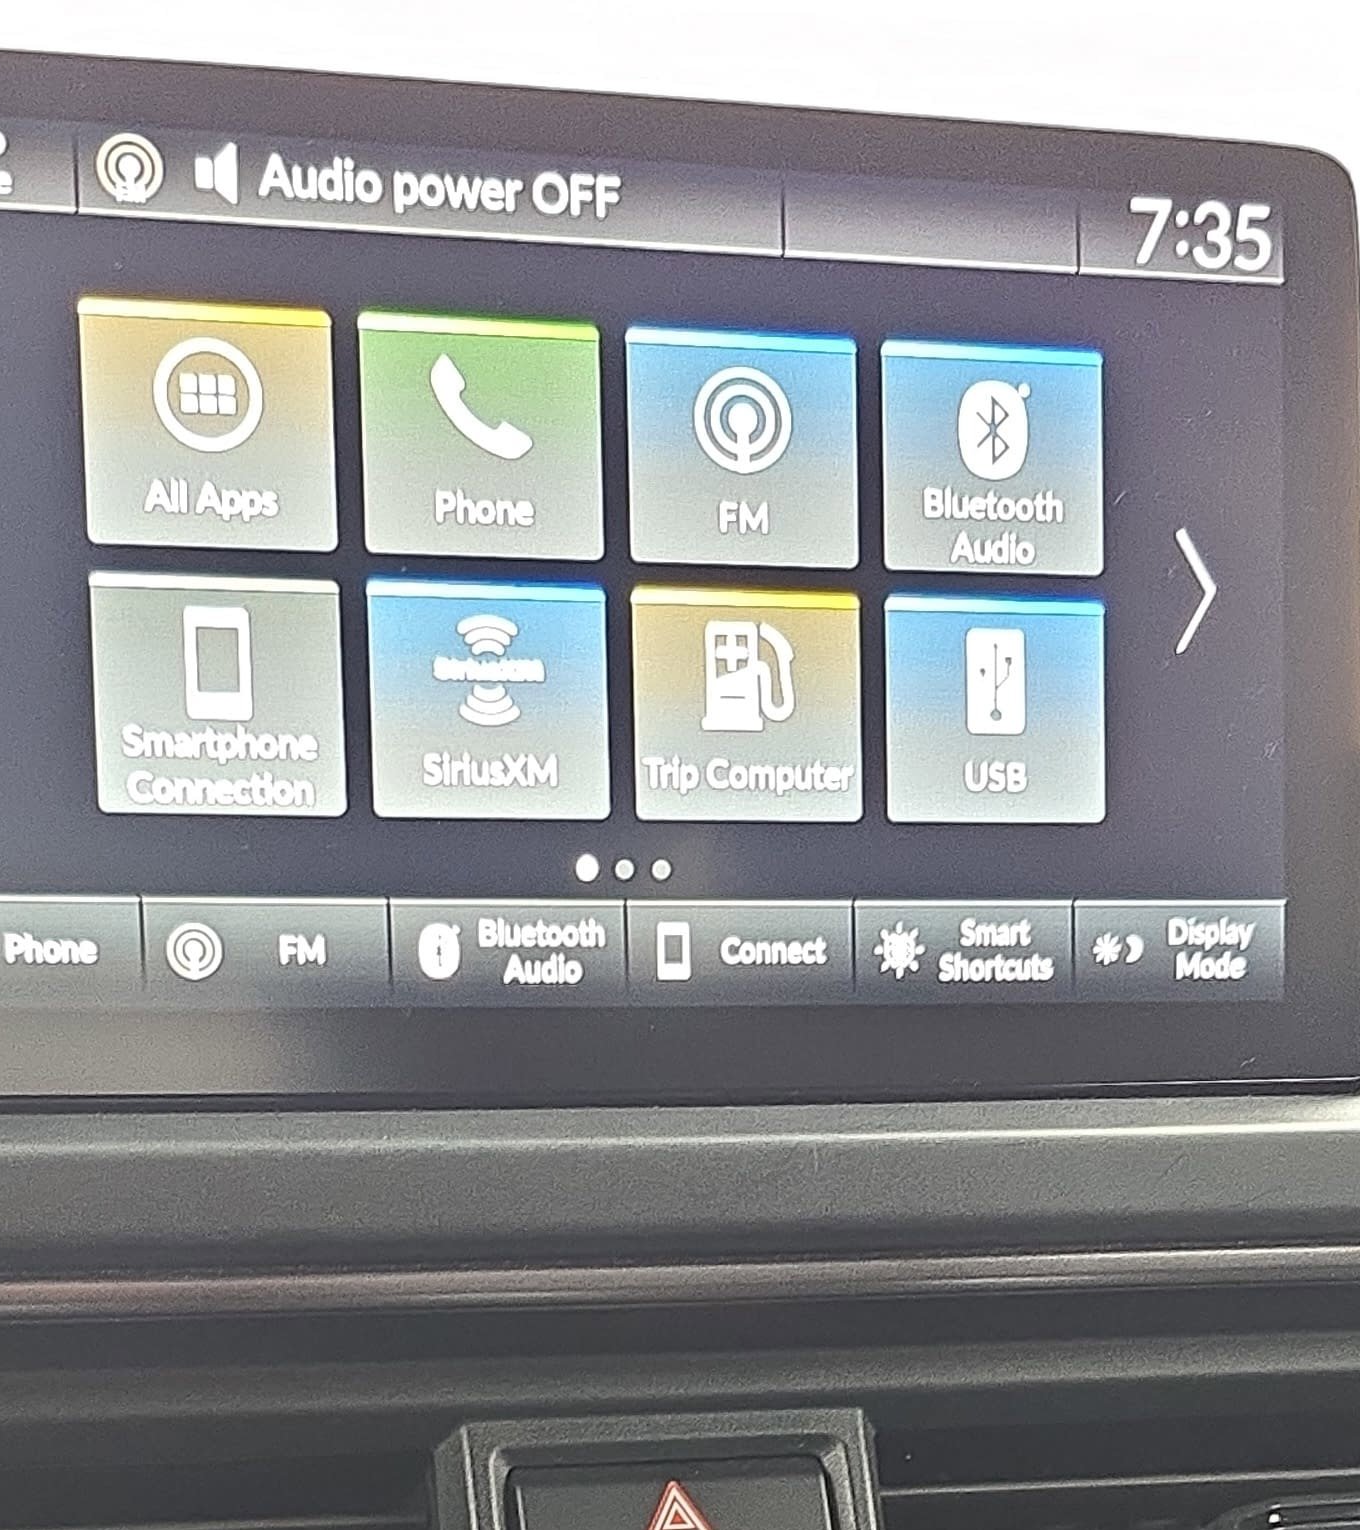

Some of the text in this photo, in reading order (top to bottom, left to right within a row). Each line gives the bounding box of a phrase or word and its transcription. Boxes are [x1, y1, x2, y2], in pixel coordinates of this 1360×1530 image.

[258, 153, 622, 219] Audio power OFF
[1129, 196, 1273, 273] 7:35
[144, 478, 280, 521] All Apps
[433, 490, 535, 526] Phone
[922, 486, 1064, 526] Bluetooth
[718, 501, 769, 536] FM
[950, 531, 1036, 567] Audio
[121, 725, 320, 765] Smartphone
[423, 752, 559, 787] SiriusXM
[643, 757, 853, 795] Trip Computer
[964, 762, 1028, 794] USB
[126, 770, 316, 808] Connection
[3, 932, 99, 967] Phone
[278, 934, 327, 966] FM
[477, 917, 606, 949] Bluetooth
[959, 918, 1032, 951] Smart
[1167, 918, 1256, 953] Display
[503, 952, 584, 985] Audio
[720, 936, 827, 966] Connect
[937, 951, 1055, 985] Shortcuts
[1175, 950, 1247, 981] Mode
